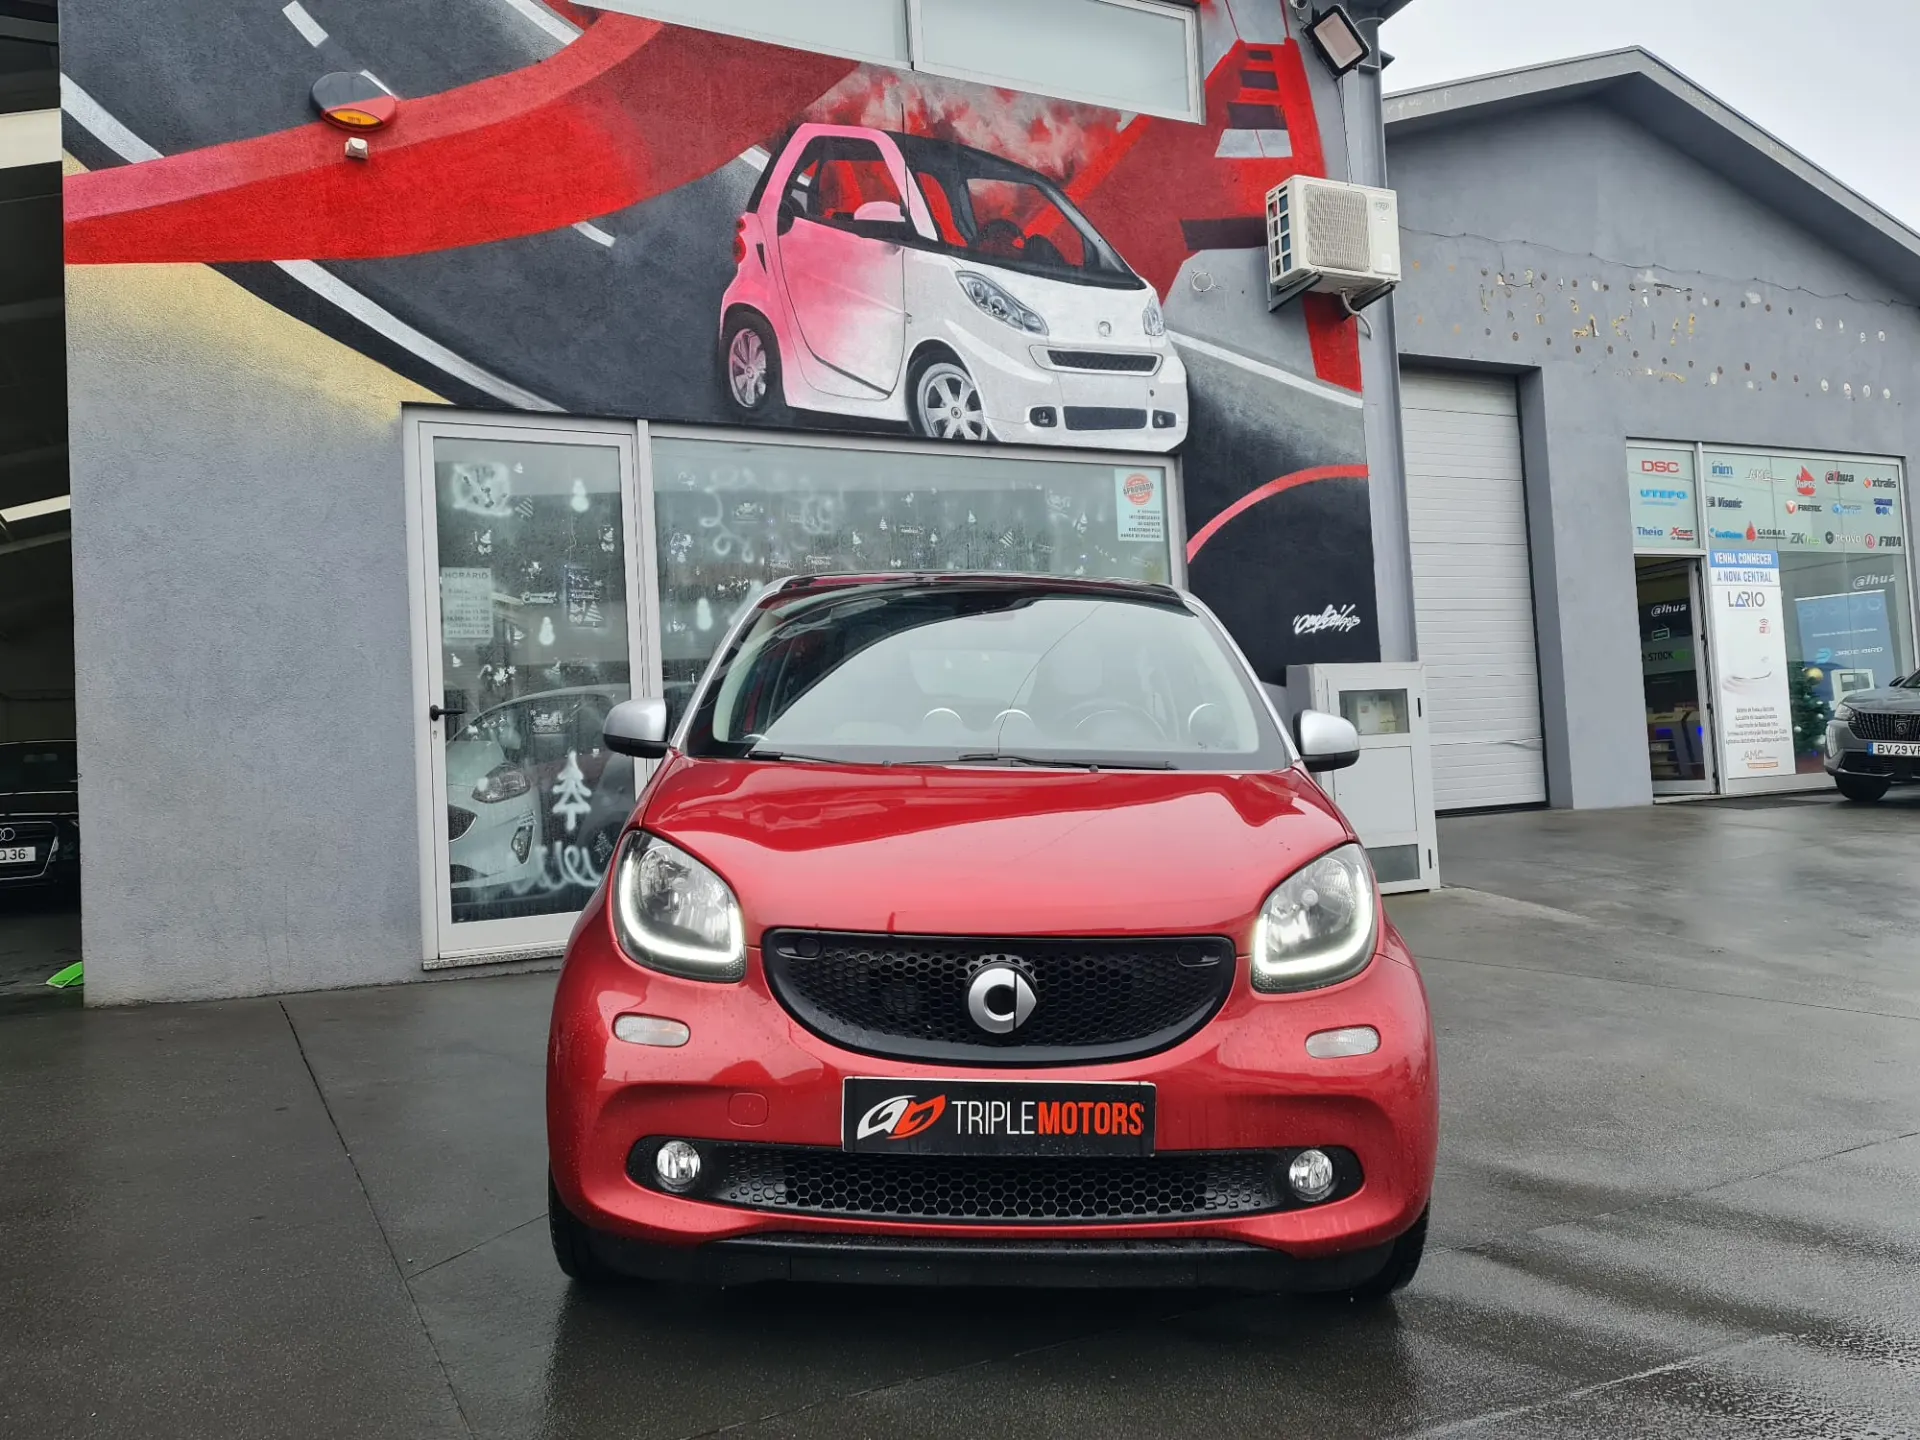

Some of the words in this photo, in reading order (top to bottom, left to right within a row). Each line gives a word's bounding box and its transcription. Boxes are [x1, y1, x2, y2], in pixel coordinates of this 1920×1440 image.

[1641, 460, 1679, 473] DSC
[1718, 496, 1744, 509] Visonic
[1714, 551, 1737, 565] VENHA
[1738, 552, 1772, 565] CONHECER
[1717, 570, 1722, 582] A
[1723, 570, 1742, 582] NOVA
[1743, 570, 1773, 583] CENTRAL
[1728, 591, 1766, 608] LARIO
[1648, 651, 1675, 661] STOCK
[1877, 744, 1893, 754] BV
[1894, 745, 1908, 755] 29
[9, 848, 26, 860] 36
